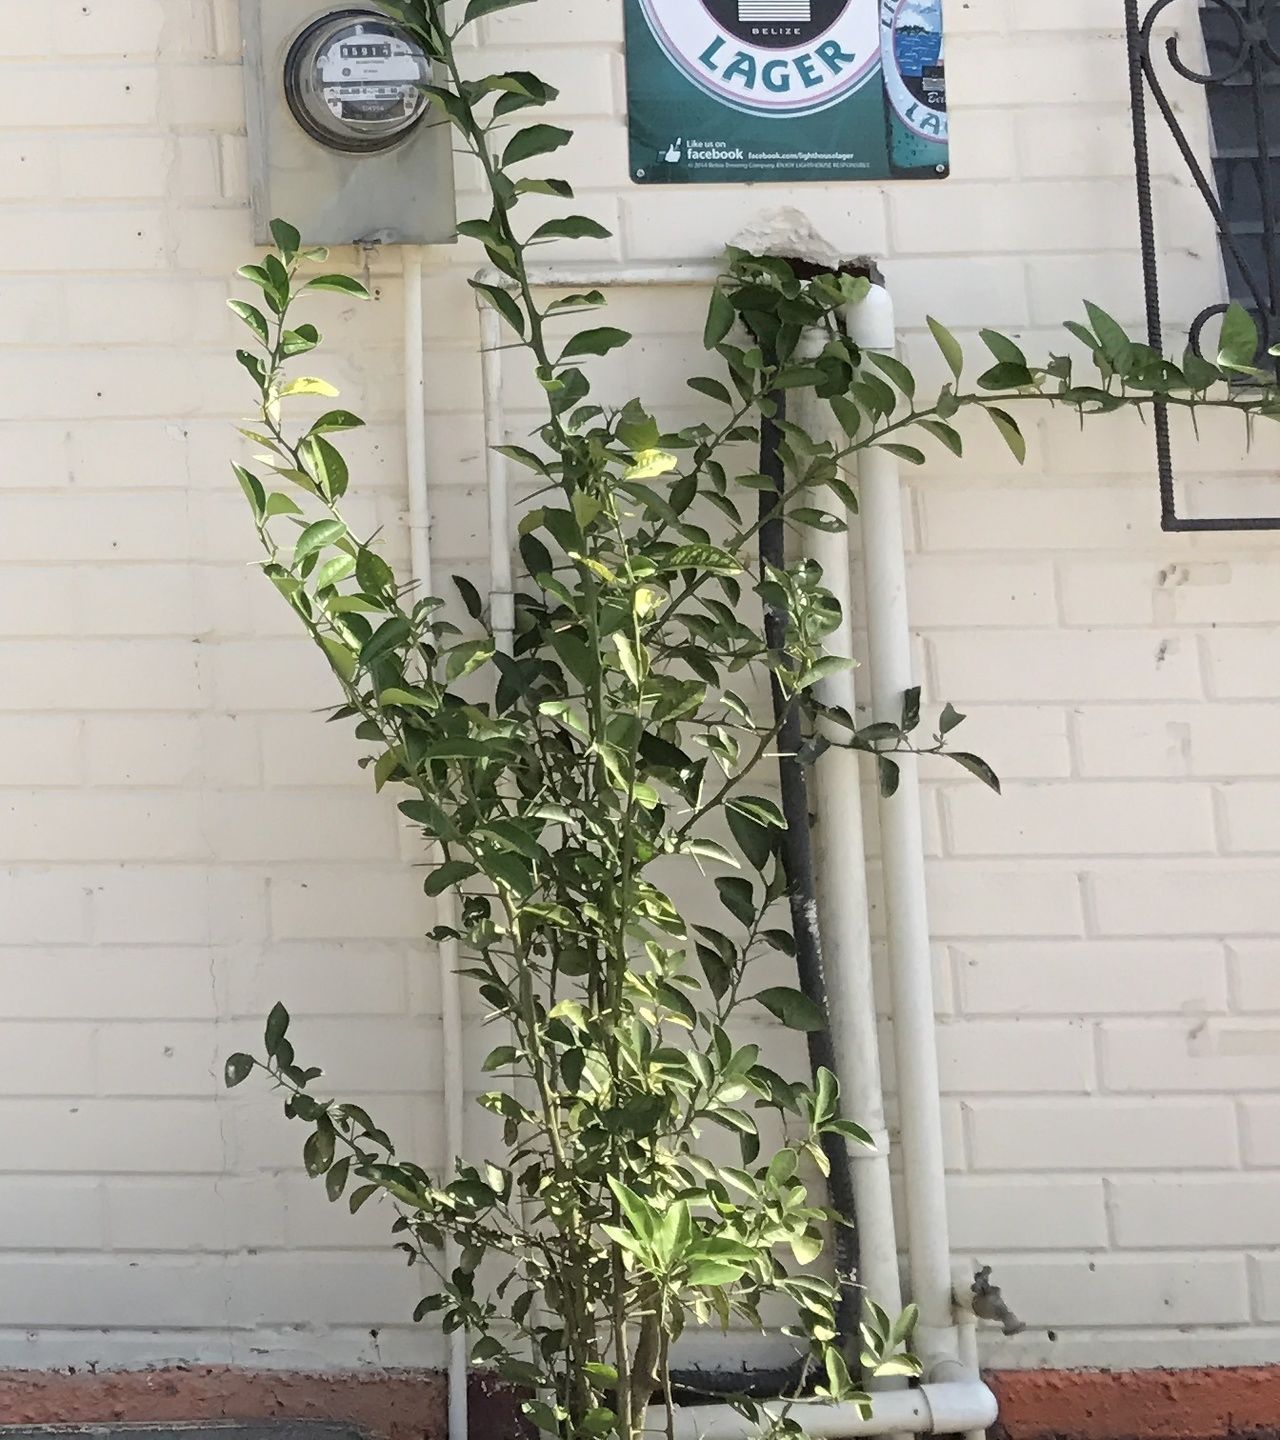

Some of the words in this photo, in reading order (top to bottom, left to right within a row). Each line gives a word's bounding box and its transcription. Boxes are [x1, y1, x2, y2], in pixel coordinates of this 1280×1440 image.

[752, 27, 801, 35] BELIZE
[698, 35, 856, 93] LAGER
[687, 140, 703, 148] Like
[687, 148, 743, 160] facebook
